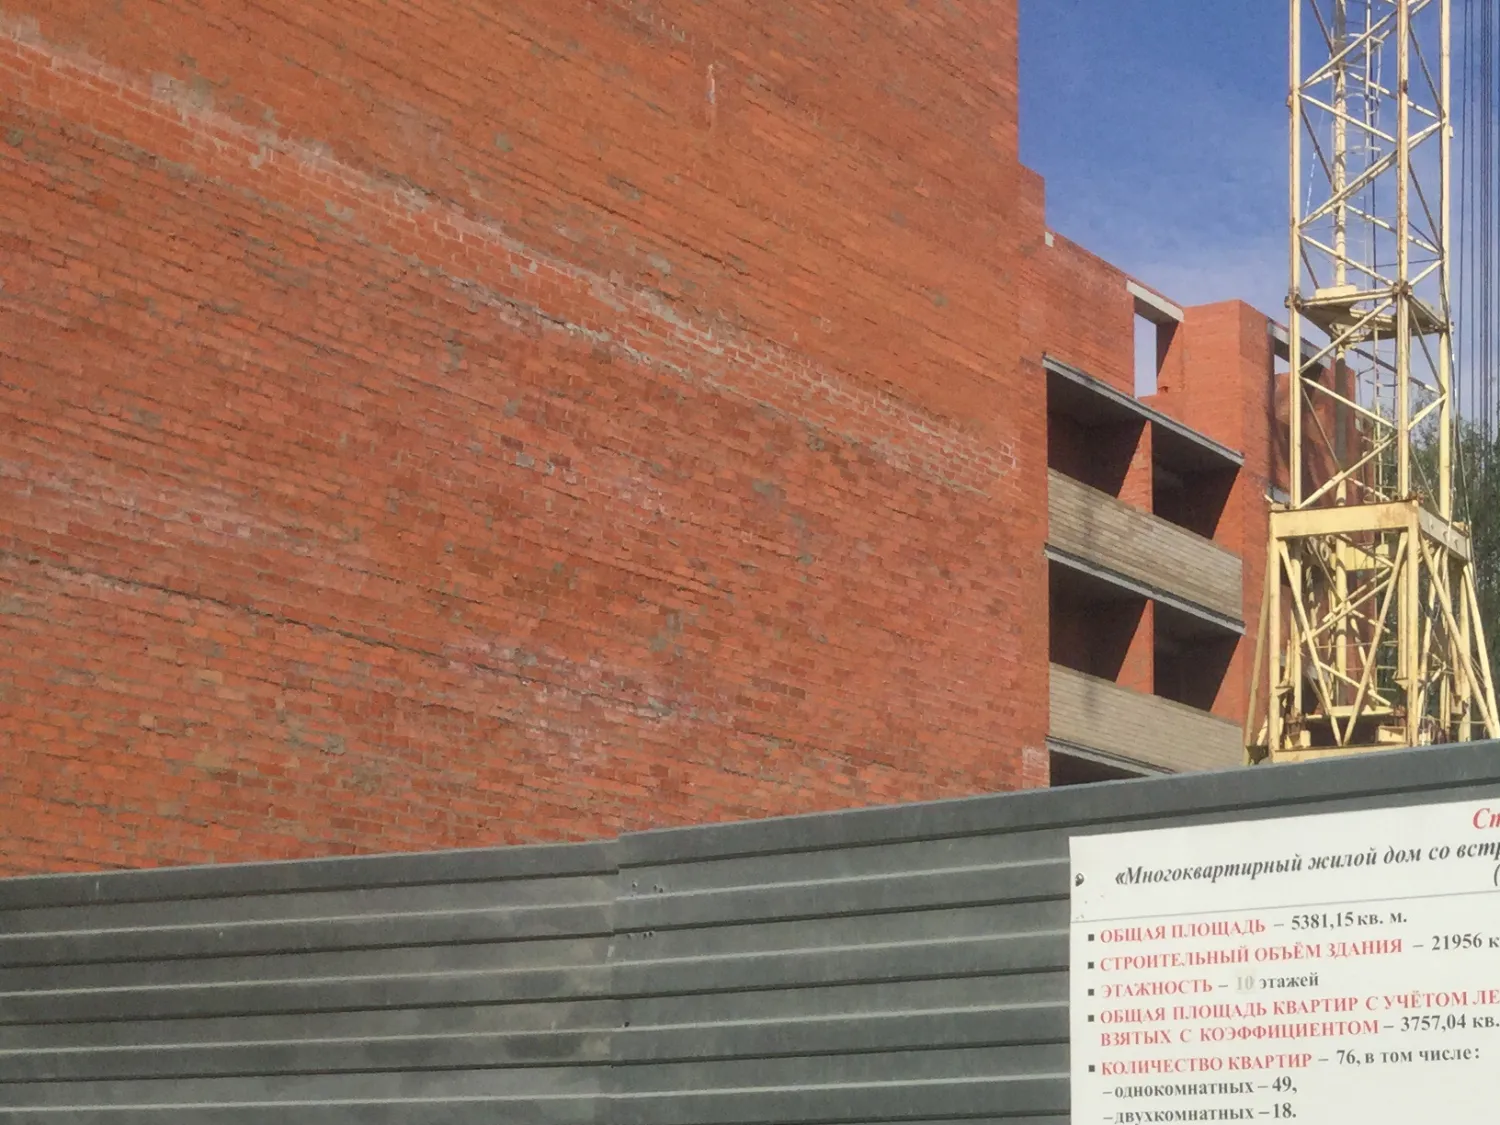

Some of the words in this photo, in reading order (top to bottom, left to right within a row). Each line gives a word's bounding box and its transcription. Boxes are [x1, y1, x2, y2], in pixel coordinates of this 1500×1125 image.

[1114, 853, 1303, 886] «Многоквартирный
[1307, 846, 1378, 871] жилой
[1382, 845, 1422, 865] дом
[1427, 845, 1451, 861] со
[1099, 925, 1166, 944] ОБЩАЯ
[1171, 919, 1266, 939] ПЛОЩАДЬ
[1291, 911, 1355, 931] 5381,15
[1357, 913, 1384, 926] кв.
[1389, 912, 1408, 924] м.
[1099, 945, 1249, 972] СТРОИТЕЛЬНЫЙ
[1328, 938, 1402, 960] ЗДАНИЯ
[1431, 932, 1483, 952] 21956
[1105, 978, 1213, 998] ЭТАЖНОСТЬ
[1259, 971, 1319, 990] этажей
[1099, 1007, 1166, 1025] ОБЩАЯ
[1173, 1001, 1268, 1021] ПЛОЩАДЬ
[1273, 996, 1359, 1016] КВАРТИР
[1365, 995, 1379, 1011] С
[1383, 990, 1469, 1010] УЧЁТОМ
[1100, 1029, 1172, 1047] ВЗЯТЫХ
[1179, 1029, 1192, 1043] С
[1200, 1018, 1379, 1042] КОЭФФИЦИЕНТОМ
[1400, 1013, 1467, 1033] 3757,04
[1101, 1056, 1224, 1076] КОЛИЧЕСТВО
[1228, 1052, 1313, 1071] КВАРТИР
[1336, 1048, 1362, 1067] 76,
[1364, 1052, 1375, 1064] в
[1379, 1050, 1413, 1064] том
[1418, 1047, 1480, 1062] числе:
